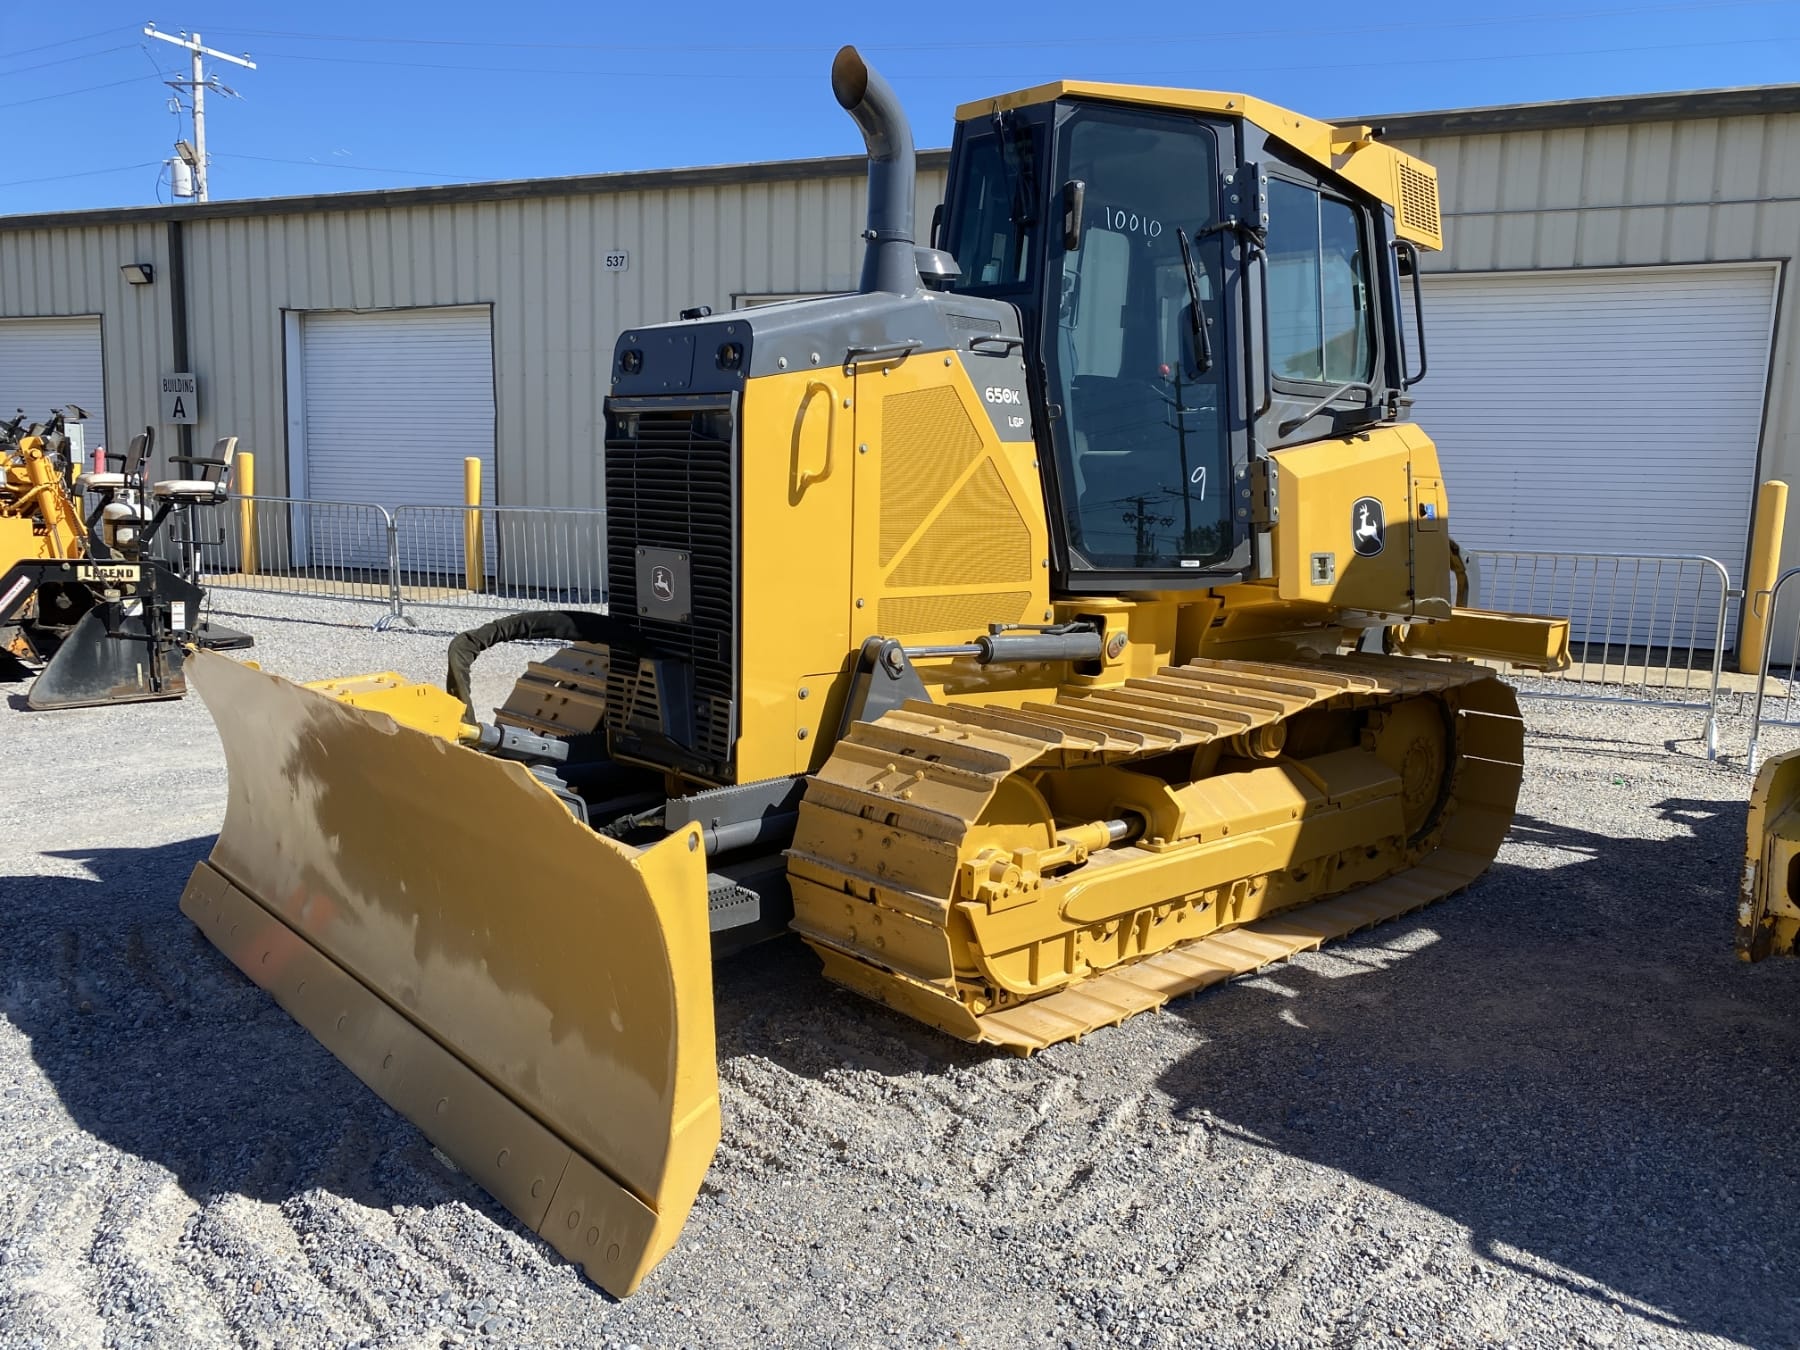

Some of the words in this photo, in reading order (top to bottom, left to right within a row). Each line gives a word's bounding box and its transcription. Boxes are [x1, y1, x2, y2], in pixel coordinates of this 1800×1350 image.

[1105, 206, 1162, 237] 10010
[606, 255, 625, 267] 537
[162, 378, 194, 393] BUILDING
[985, 387, 1021, 405] 650K
[172, 395, 187, 418] A
[1191, 466, 1206, 502] 9
